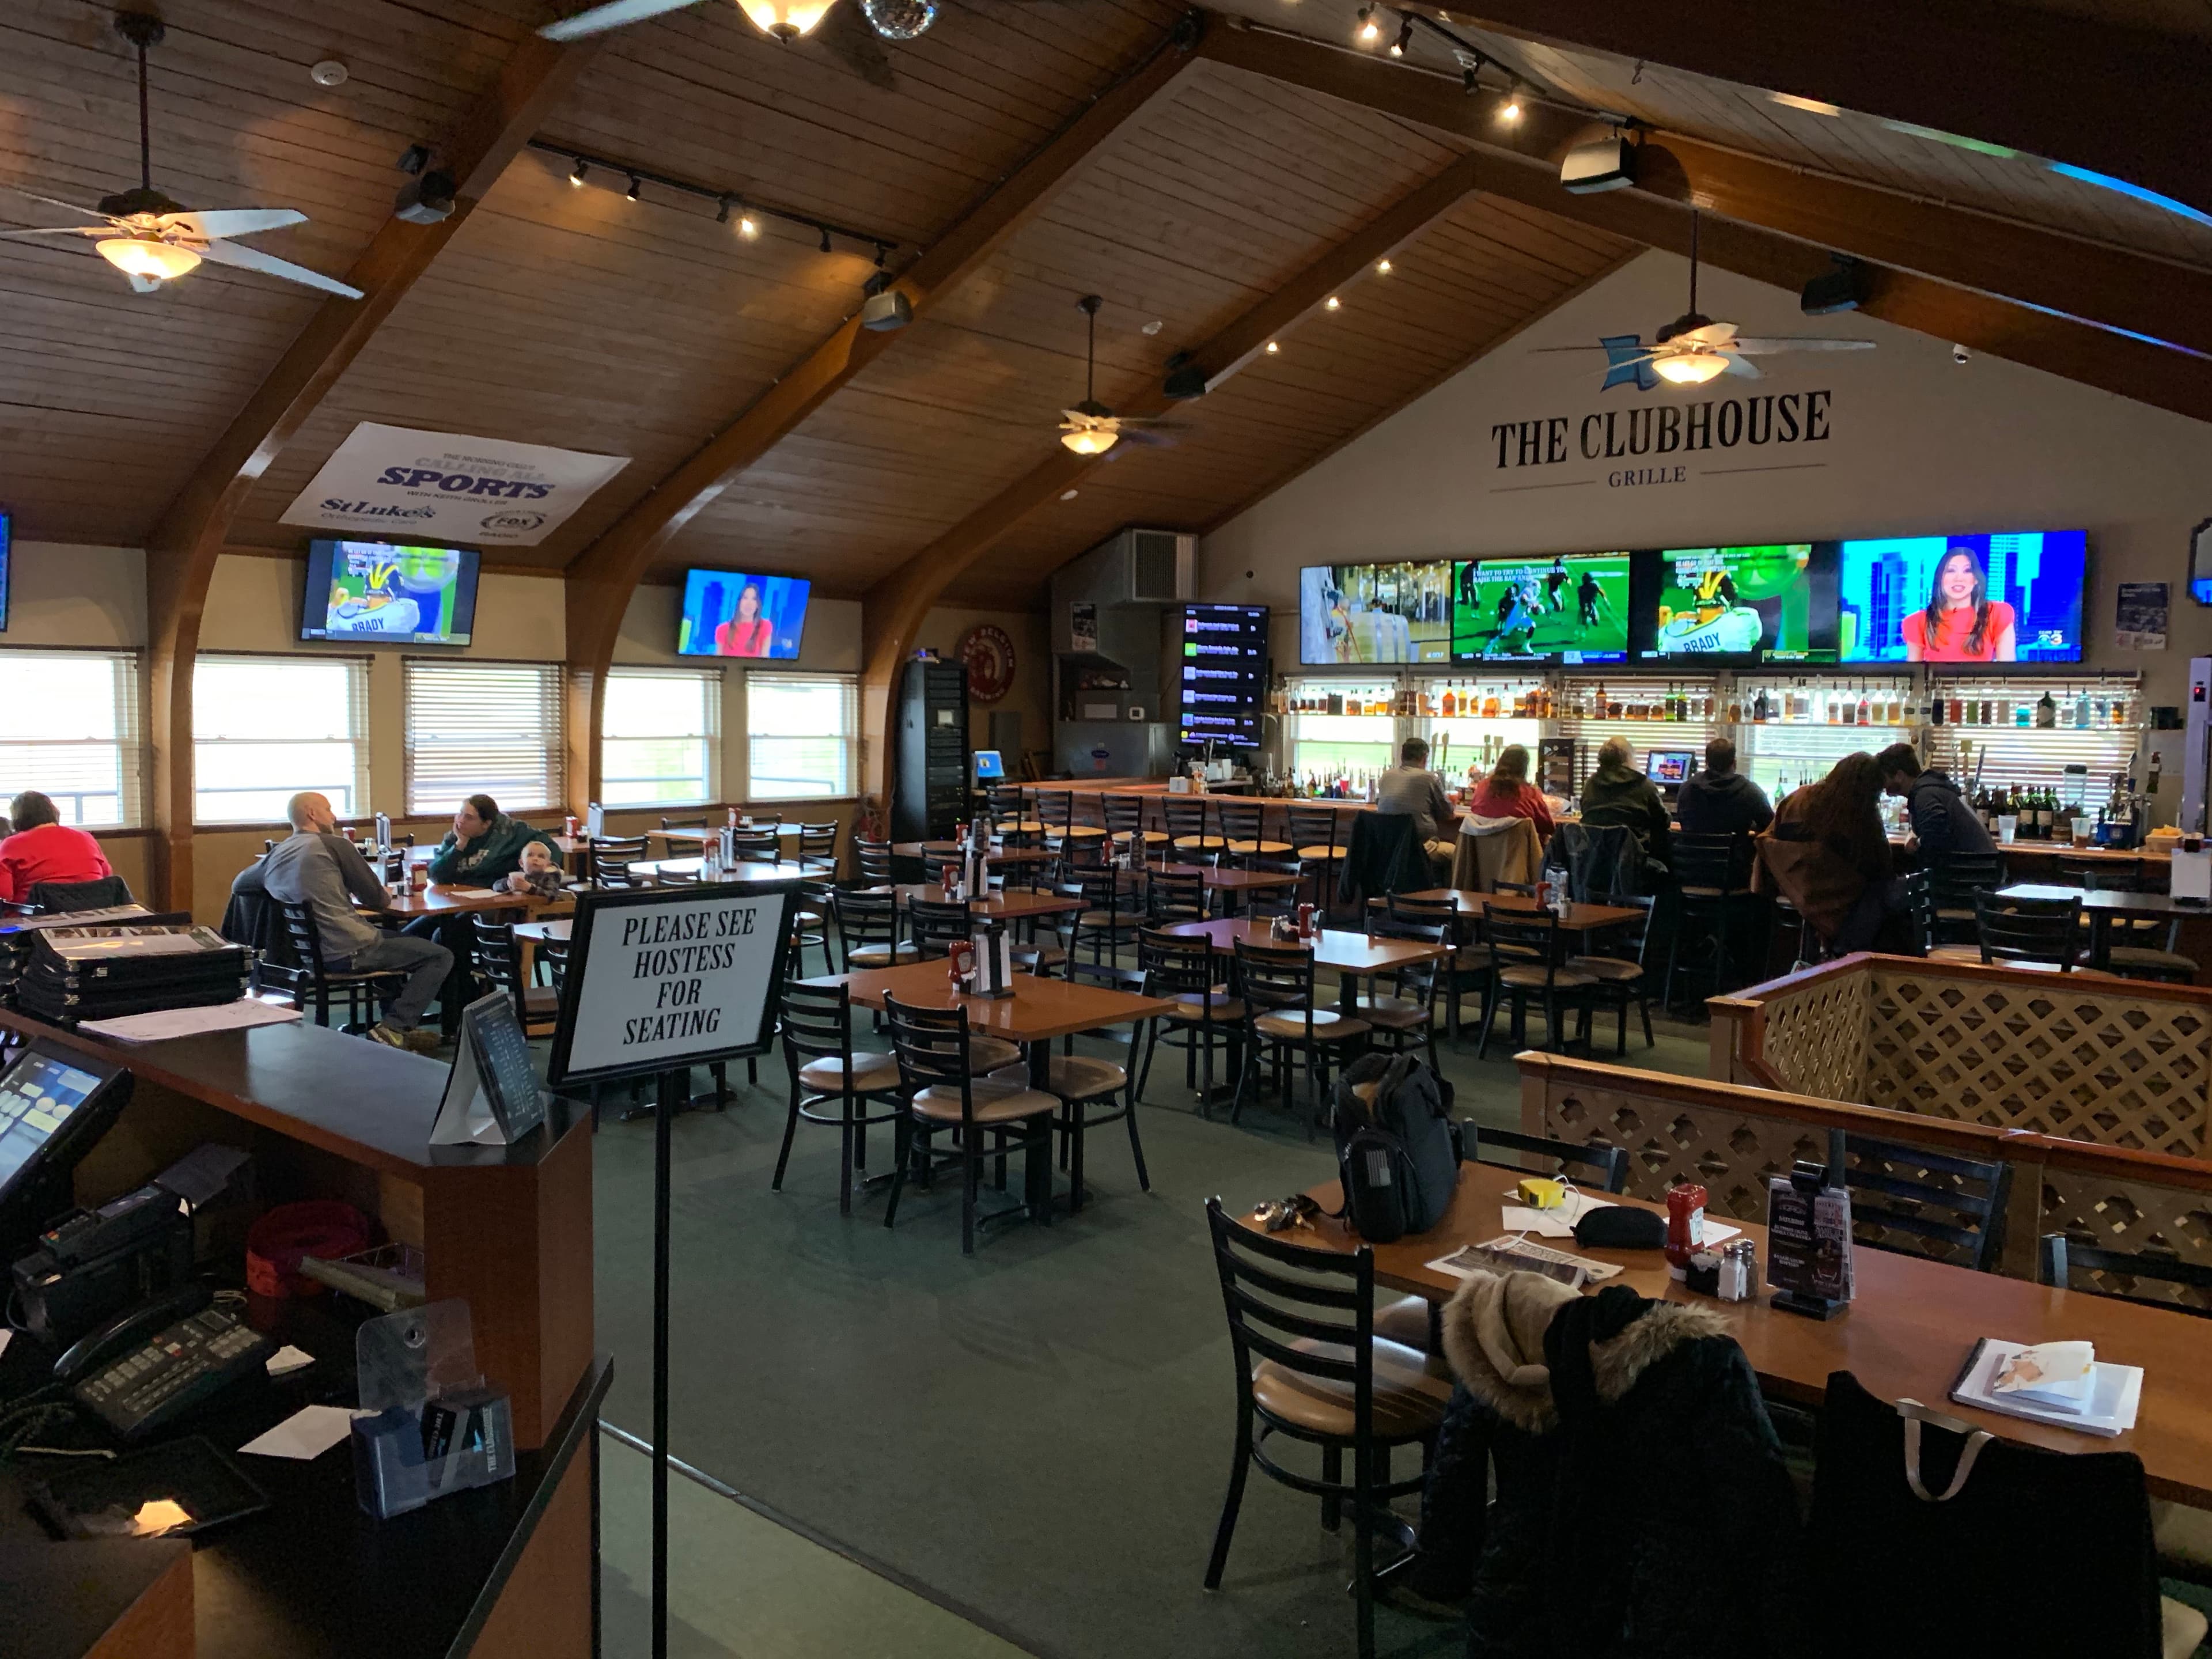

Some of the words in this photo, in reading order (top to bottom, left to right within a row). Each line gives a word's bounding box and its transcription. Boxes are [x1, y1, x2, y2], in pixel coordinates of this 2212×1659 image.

[1491, 418, 1569, 469] THE
[1580, 389, 1832, 460] CLUBHOUSE
[415, 457, 507, 476] CALLING
[510, 469, 547, 480] ALL
[443, 453, 462, 461] THE
[377, 467, 556, 499] SPORTS
[1608, 465, 1687, 488] GRILLE
[352, 618, 384, 631] BRADY
[1683, 632, 1721, 652] BRADY
[622, 912, 711, 946] PLEASE
[715, 908, 757, 937] SEE
[632, 942, 736, 979] HOSTESS
[656, 978, 702, 1009] FOR
[623, 1007, 721, 1046] SEATING
